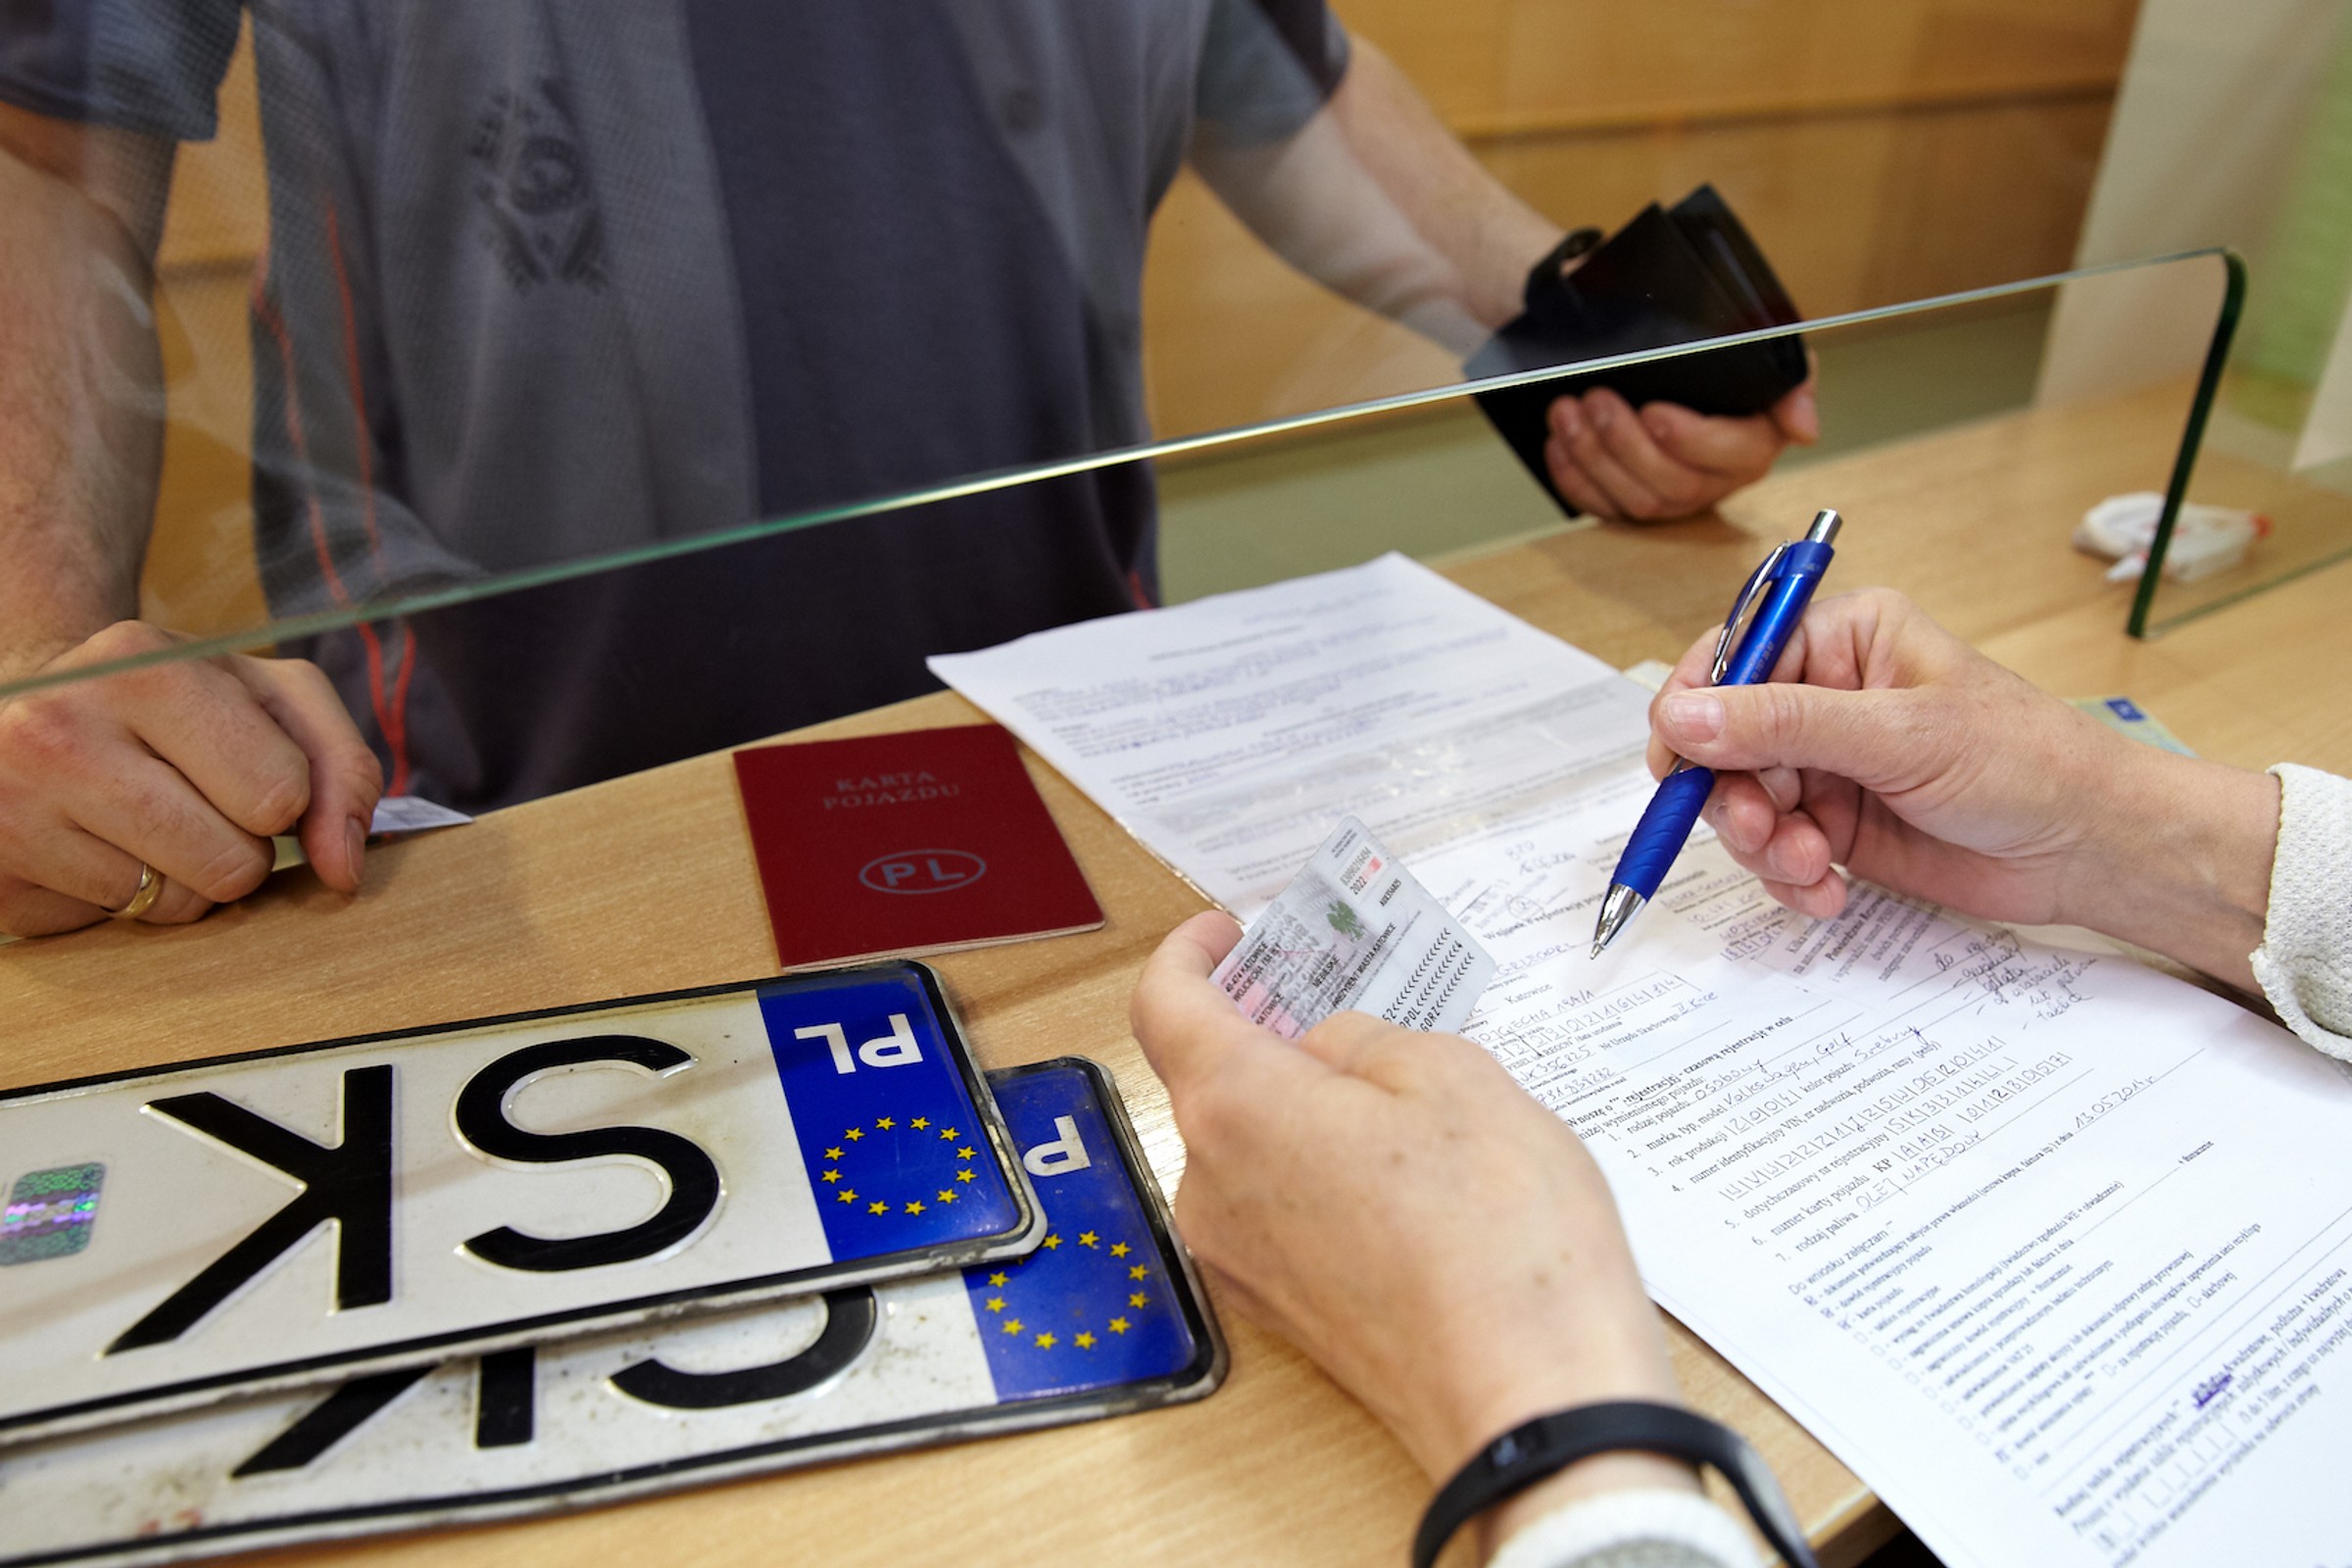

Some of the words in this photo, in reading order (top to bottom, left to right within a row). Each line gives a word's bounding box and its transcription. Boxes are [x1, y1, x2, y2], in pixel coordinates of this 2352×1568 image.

[821, 783, 961, 810] POJAZDU
[834, 770, 938, 794] KARTA
[879, 858, 967, 888] PL
[1240, 939, 1268, 974] KATOWICE
[1254, 991, 1285, 1026] KATOWICE
[793, 1012, 924, 1074] PL
[1602, 1095, 1670, 1128] wymienionego
[1626, 1114, 1658, 1135] rodzaj
[1024, 1114, 1092, 1178] P
[1689, 1163, 1721, 1185] numer
[1799, 1197, 1834, 1216] karty
[1872, 1157, 1892, 1173] KP
[103, 1034, 722, 1358] SK
[1794, 1229, 1831, 1252] rodzaj
[1825, 1212, 1859, 1237] paliwa
